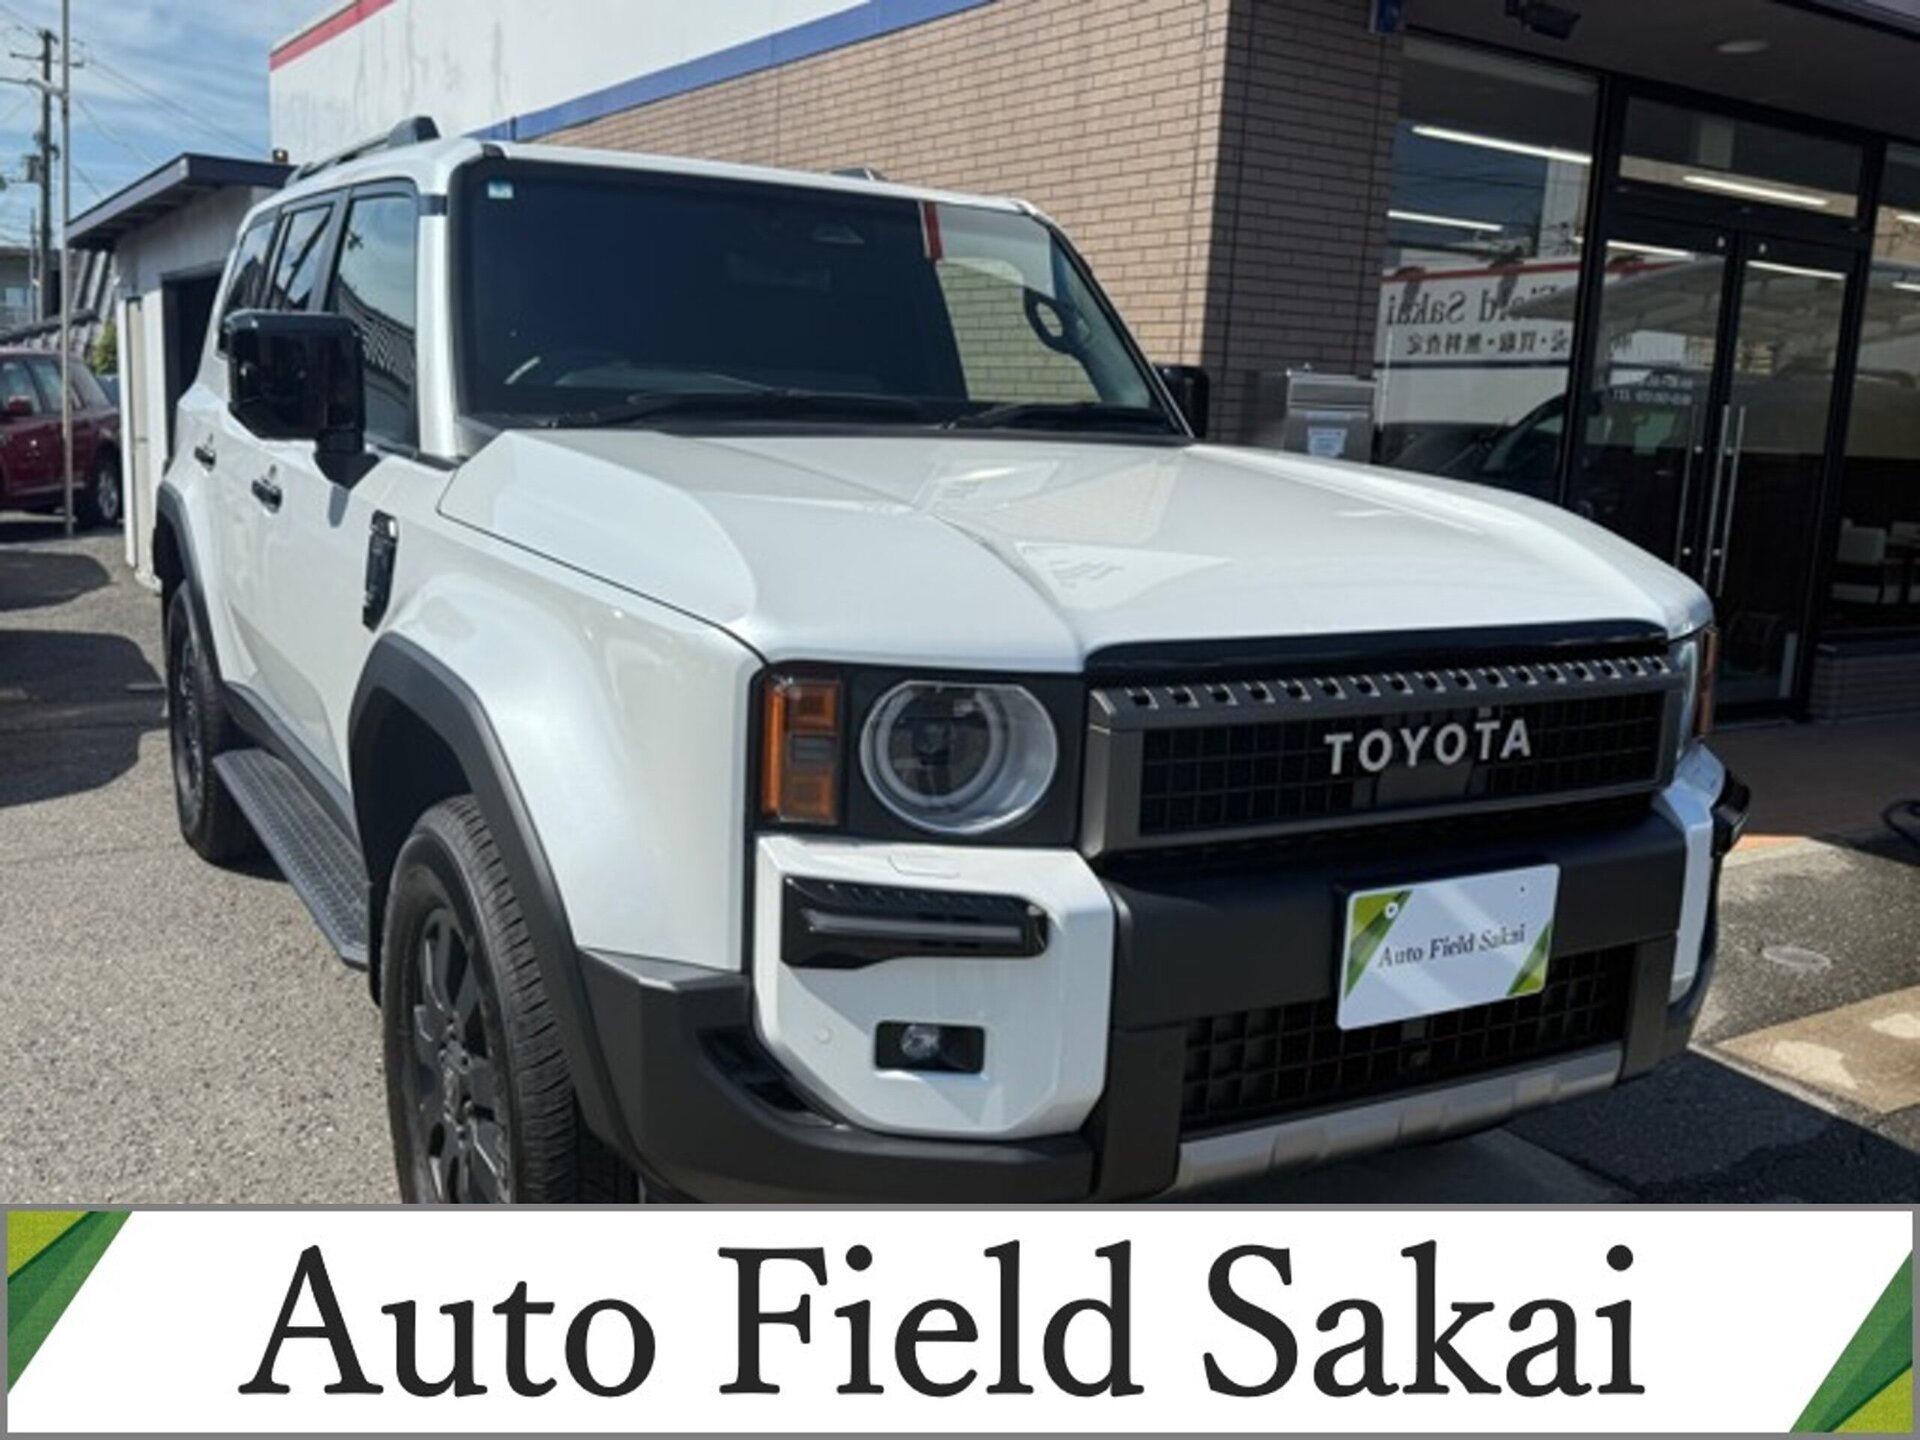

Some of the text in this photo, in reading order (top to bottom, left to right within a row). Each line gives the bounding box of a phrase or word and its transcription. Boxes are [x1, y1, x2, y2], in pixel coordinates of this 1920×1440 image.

[1323, 718, 1532, 776] TOYOTA
[1378, 923, 1526, 969] Auto Field Sakai
